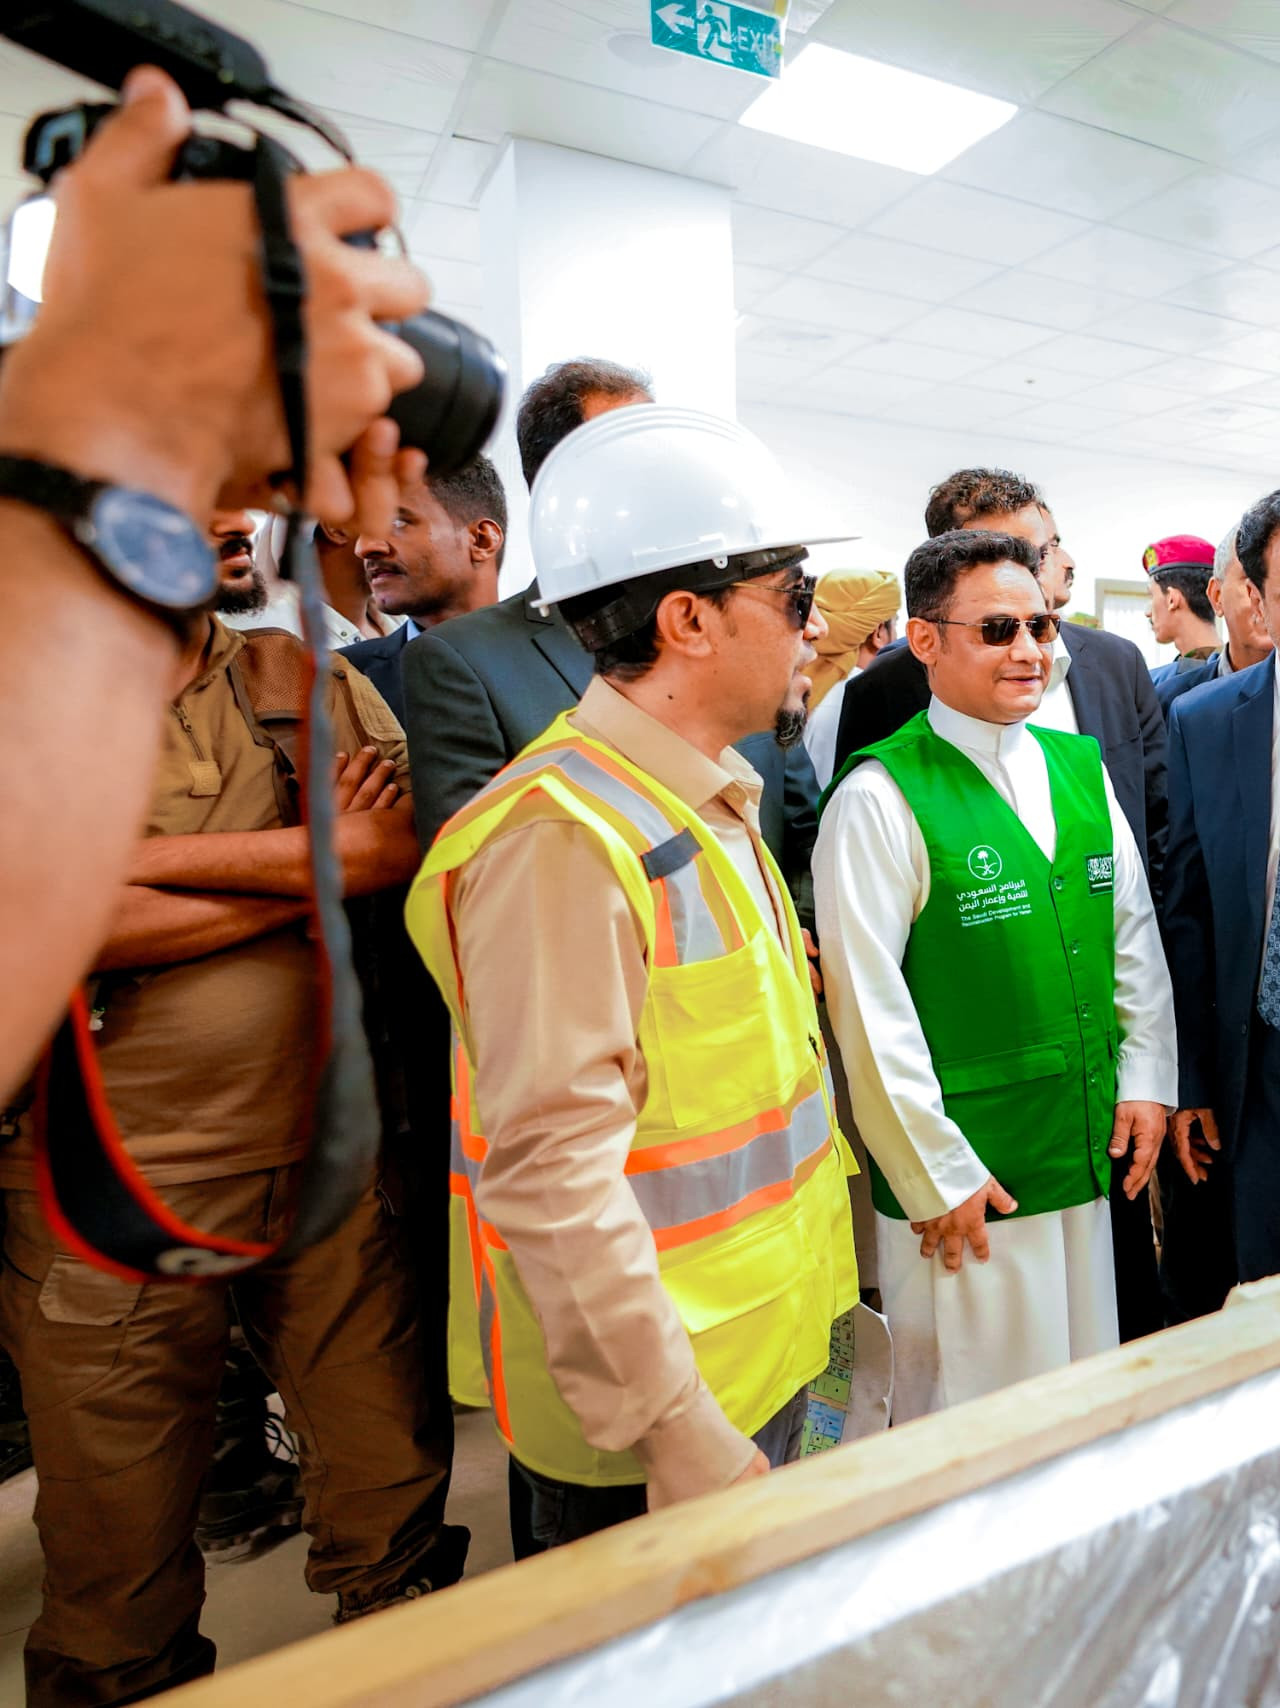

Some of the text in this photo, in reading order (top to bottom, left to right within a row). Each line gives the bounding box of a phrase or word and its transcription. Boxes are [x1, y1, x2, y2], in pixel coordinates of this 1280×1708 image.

[737, 25, 778, 53] EXIT
[956, 880, 1026, 901] البرنامج السعودي
[958, 899, 980, 912] اليمن
